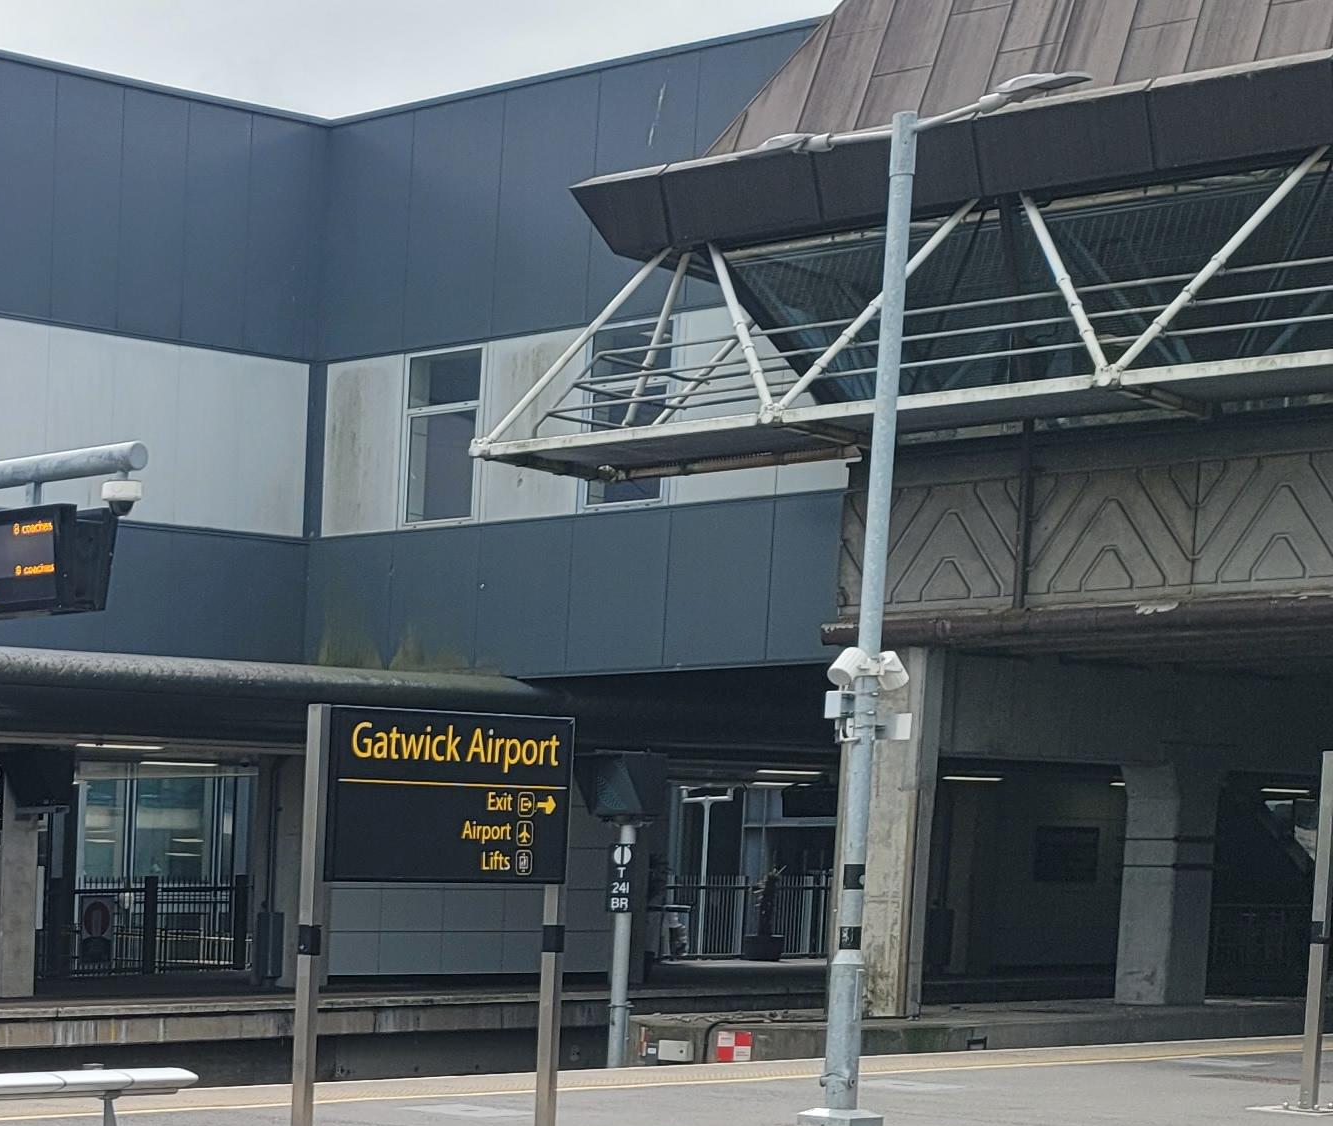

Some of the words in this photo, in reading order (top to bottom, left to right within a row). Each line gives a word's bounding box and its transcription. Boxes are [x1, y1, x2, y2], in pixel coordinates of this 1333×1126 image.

[21, 520, 54, 534] coaches
[23, 562, 55, 575] coaches
[350, 720, 462, 762] Gatwick
[465, 727, 560, 774] Airport
[487, 791, 512, 812] Exit
[460, 819, 512, 844] Airport
[480, 850, 511, 871] Lifts
[617, 866, 627, 878] T
[611, 881, 630, 894] 241
[610, 897, 629, 910] BR
